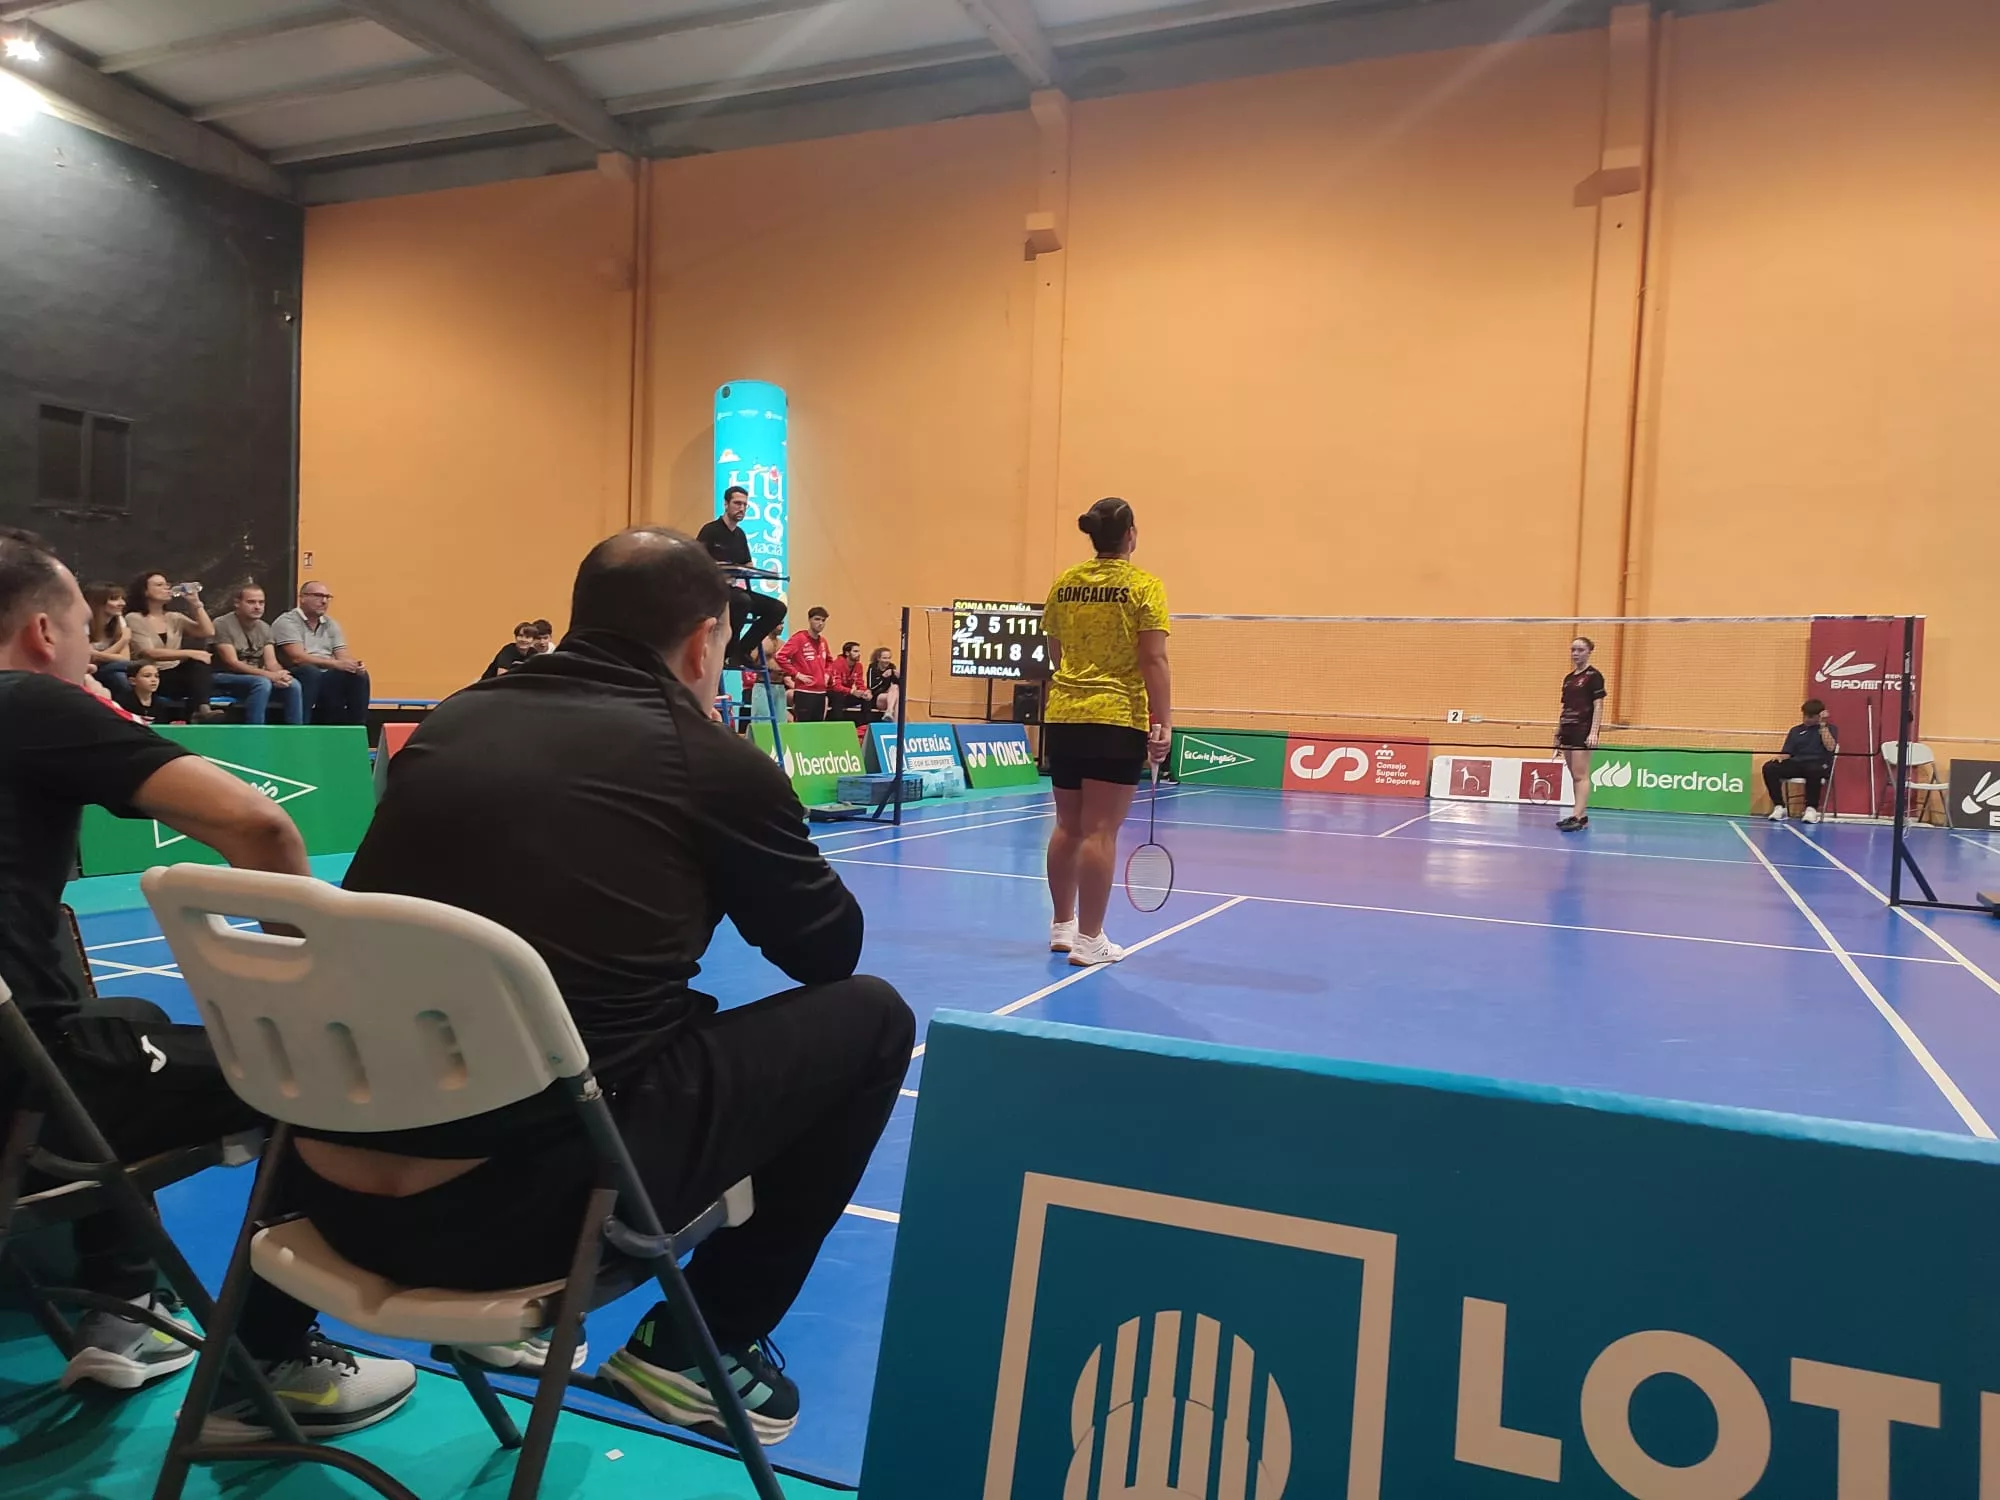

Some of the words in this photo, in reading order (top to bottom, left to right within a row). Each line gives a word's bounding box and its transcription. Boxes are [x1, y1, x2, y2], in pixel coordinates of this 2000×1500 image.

[966, 614, 979, 632] 9
[988, 616, 1001, 633] 5
[952, 646, 960, 656] 2
[1009, 643, 1022, 661] 8
[1031, 645, 1045, 662] 4
[1451, 711, 1459, 721] 2
[903, 734, 951, 753] LOTERÍAS
[795, 750, 862, 776] Iberdrola
[988, 741, 1032, 767] YONEX
[1376, 762, 1407, 771] Consejo
[1376, 770, 1408, 778] Superior
[1386, 777, 1421, 786] Deportes
[1636, 768, 1744, 793] Iberdrola
